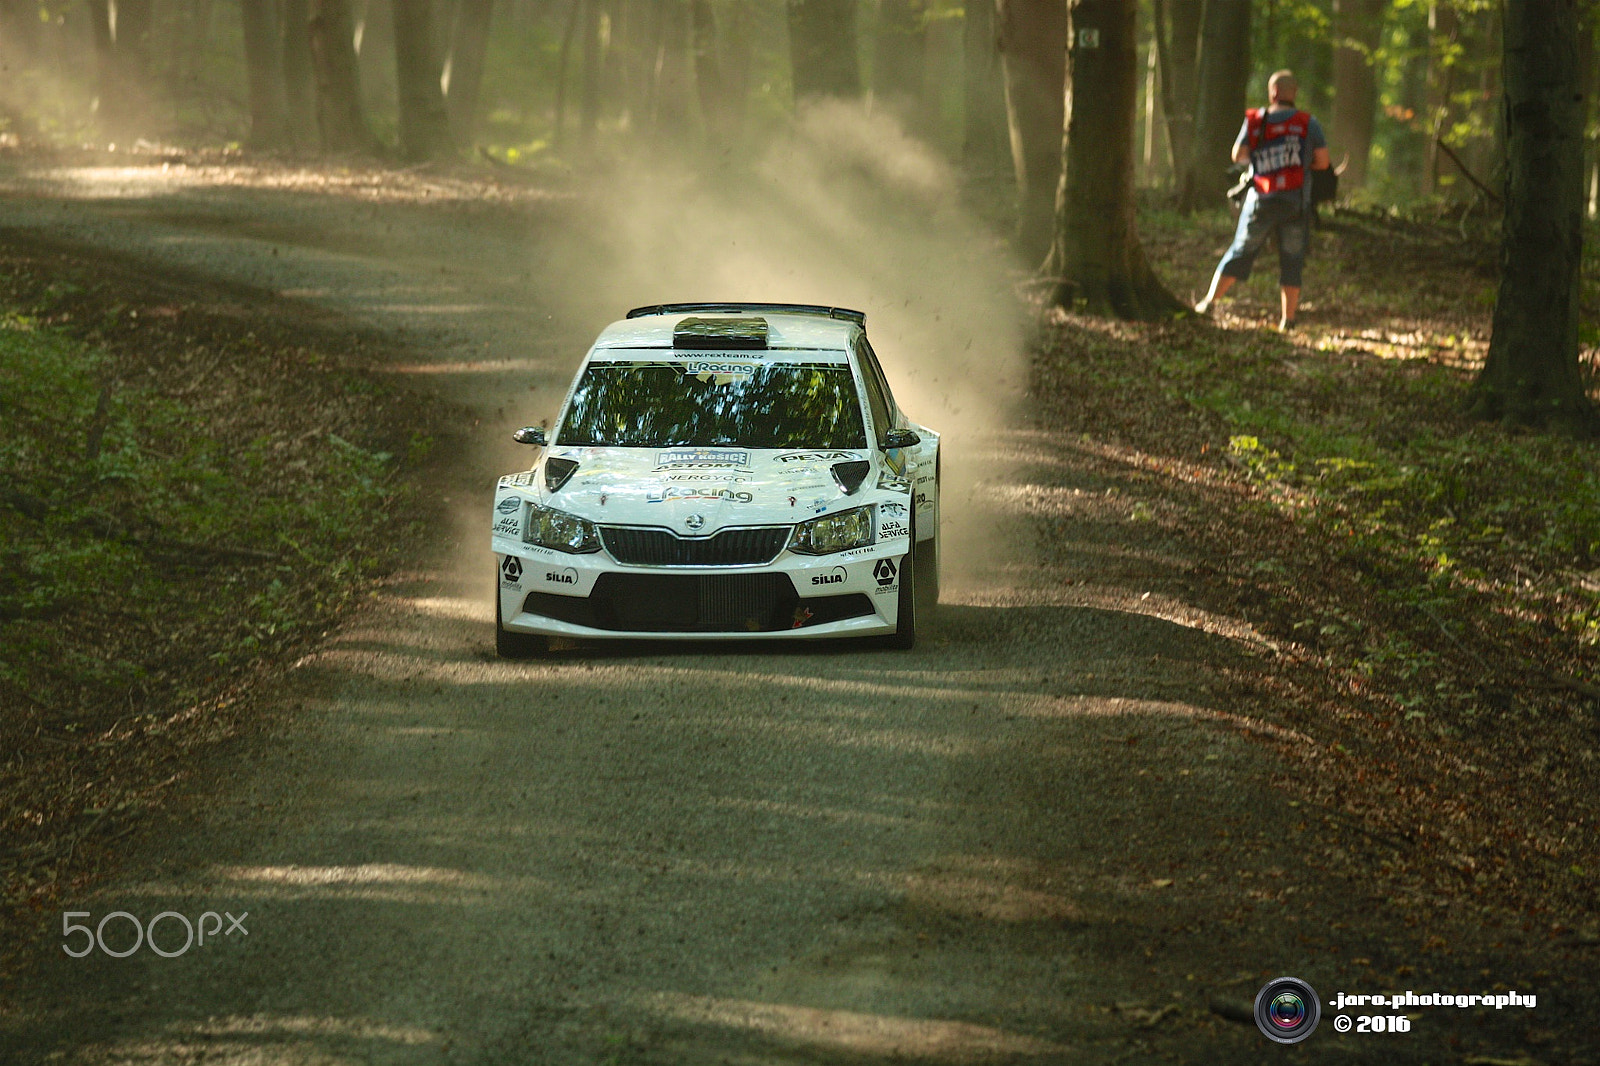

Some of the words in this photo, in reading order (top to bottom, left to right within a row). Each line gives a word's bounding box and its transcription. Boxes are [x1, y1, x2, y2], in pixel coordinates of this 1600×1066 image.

[674, 352, 764, 360] www.rexteam.cz
[659, 453, 693, 464] RALLY
[780, 453, 850, 463] PEVA
[660, 475, 746, 484] NERGYCO
[500, 517, 519, 527] ALFA
[881, 521, 901, 531] ALFA
